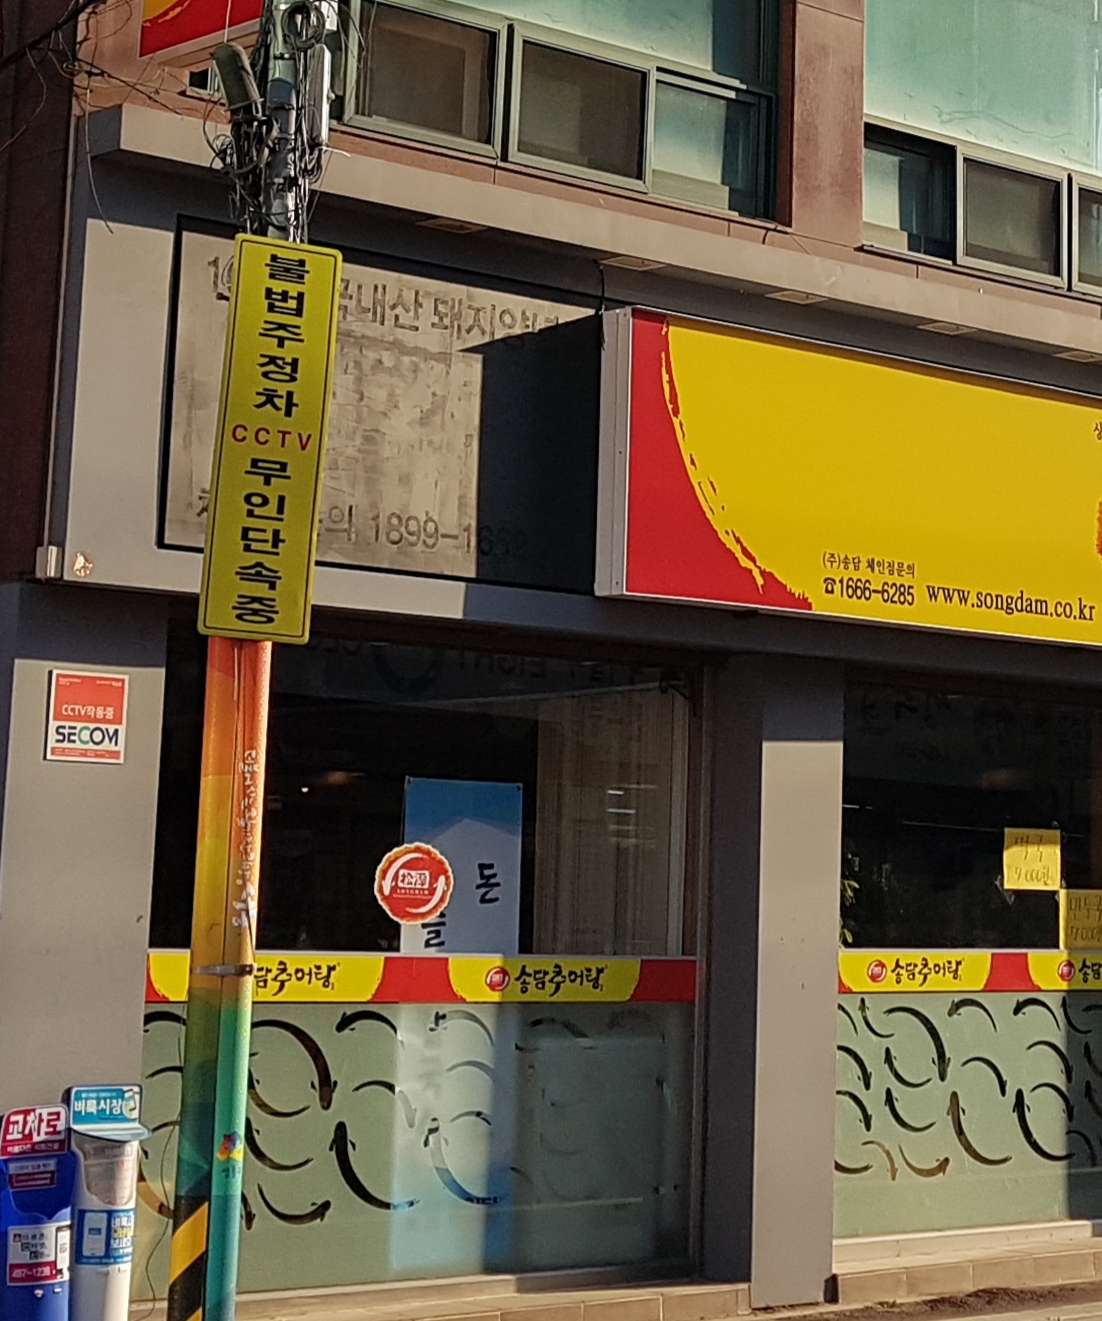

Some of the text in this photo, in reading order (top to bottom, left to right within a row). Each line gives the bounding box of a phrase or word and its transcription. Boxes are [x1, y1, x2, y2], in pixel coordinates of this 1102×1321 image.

[252, 253, 311, 419] 불법주정차
[231, 423, 313, 451] CCTV
[230, 457, 293, 626] 무인단속중
[822, 550, 915, 579] (주)송담 체인점문의
[838, 576, 915, 607] 1666-6285
[926, 584, 1096, 621] www.songdam.co.kr
[55, 725, 119, 747] SECOM
[253, 963, 336, 996] 담추어탕
[514, 963, 606, 997] 송담추어탕
[890, 957, 962, 986] 송담추어탕
[5, 1111, 62, 1142] 교차로
